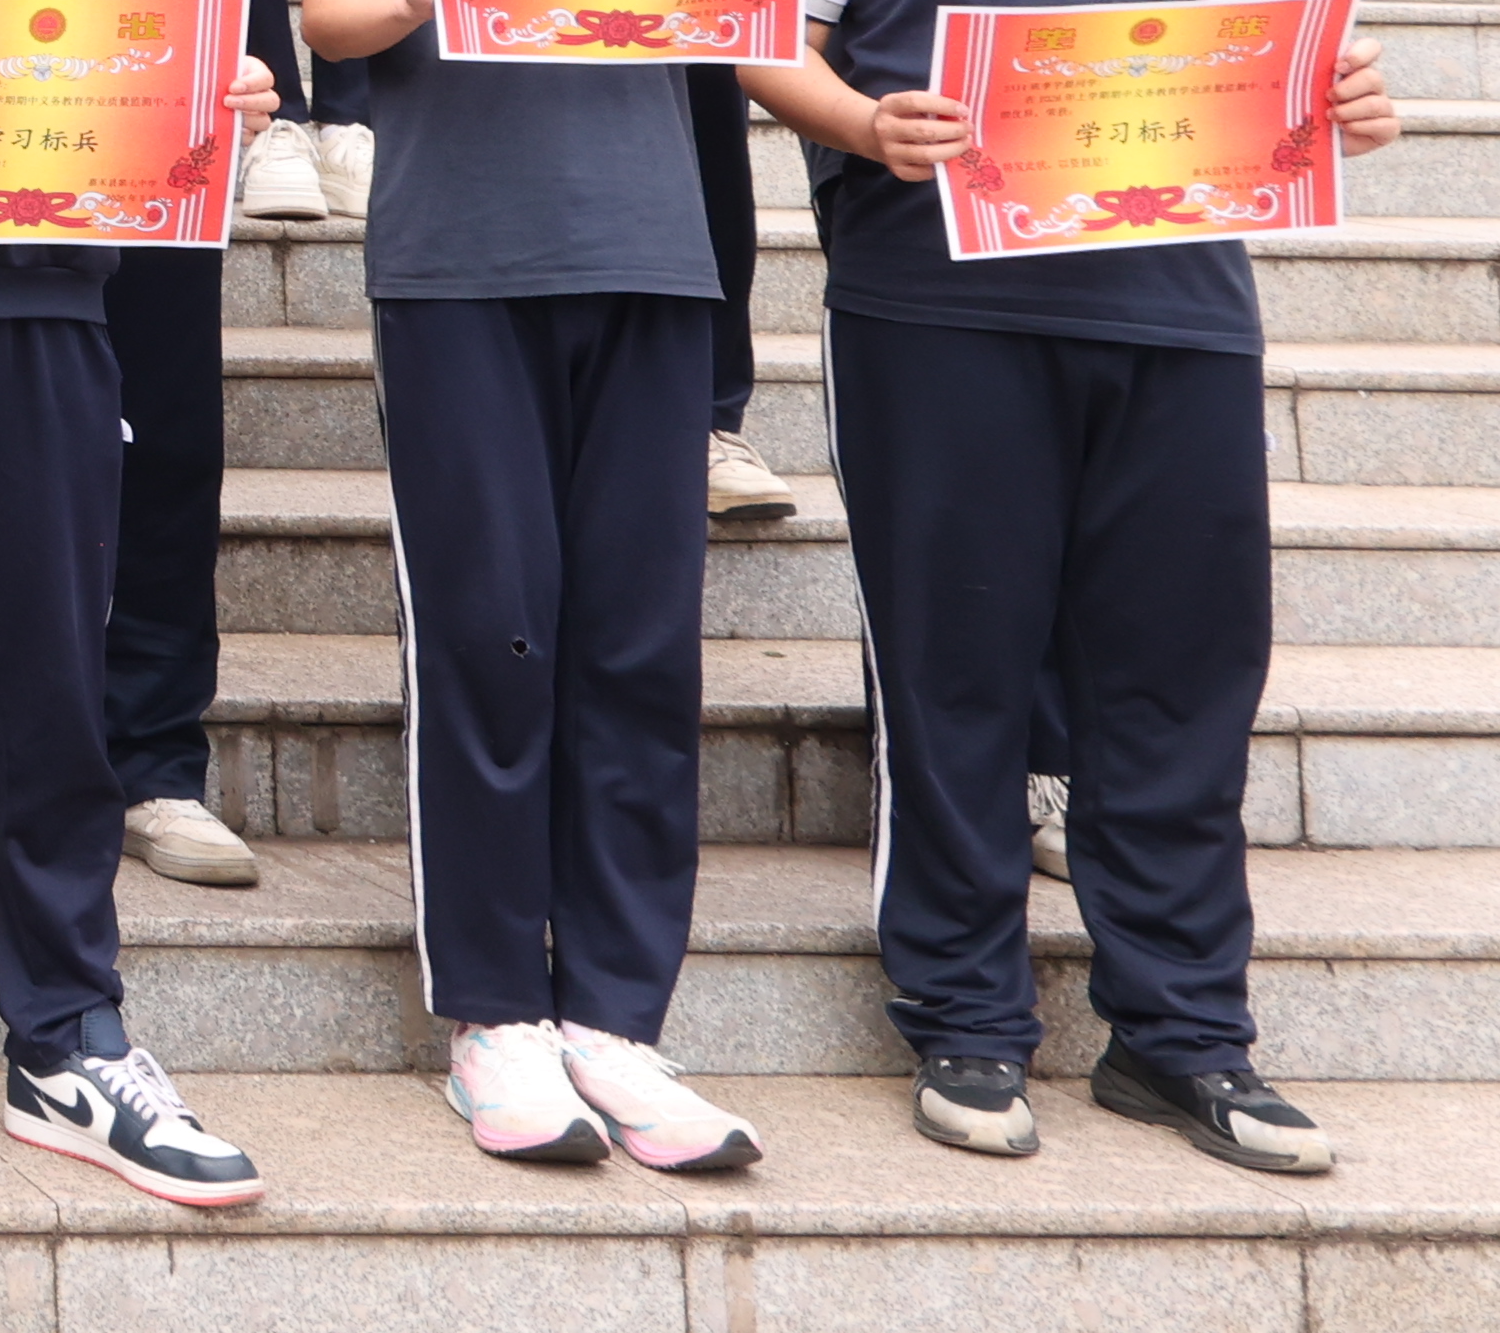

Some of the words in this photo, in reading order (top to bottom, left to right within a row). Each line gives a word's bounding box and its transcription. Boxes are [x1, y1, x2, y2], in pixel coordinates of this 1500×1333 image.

[118, 12, 165, 40] 状
[1218, 16, 1269, 39] 状
[1075, 118, 1196, 147] 学习标兵
